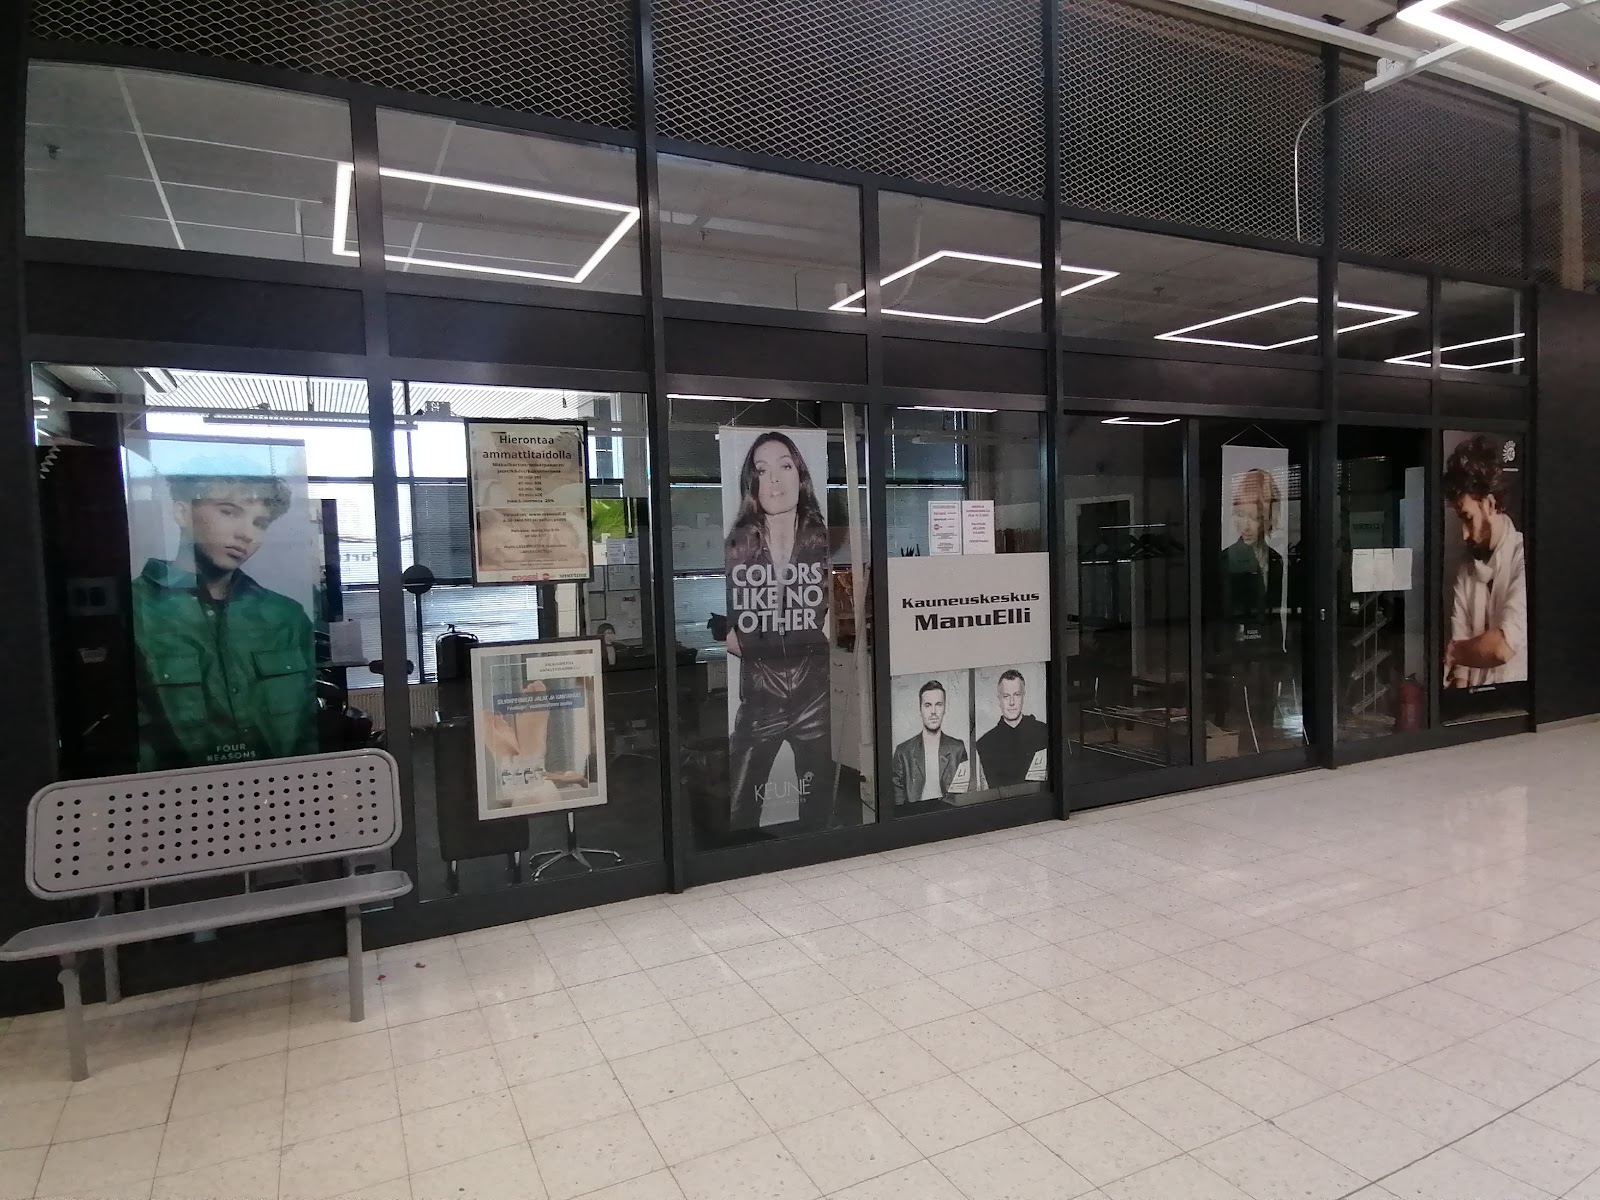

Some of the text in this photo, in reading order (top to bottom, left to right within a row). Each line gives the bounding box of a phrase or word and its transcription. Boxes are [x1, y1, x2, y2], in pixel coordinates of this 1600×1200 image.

[499, 435, 555, 445] Hierontaa
[482, 450, 572, 460] ammattitaidolla
[732, 562, 823, 587] COLORS
[732, 585, 824, 611] LIKE NO
[902, 592, 1040, 609] Kauneuskeskus
[737, 608, 818, 634] OTHER
[915, 607, 1031, 631] ManuElli
[216, 743, 246, 752] FOUR
[754, 778, 811, 802] KEUNE
